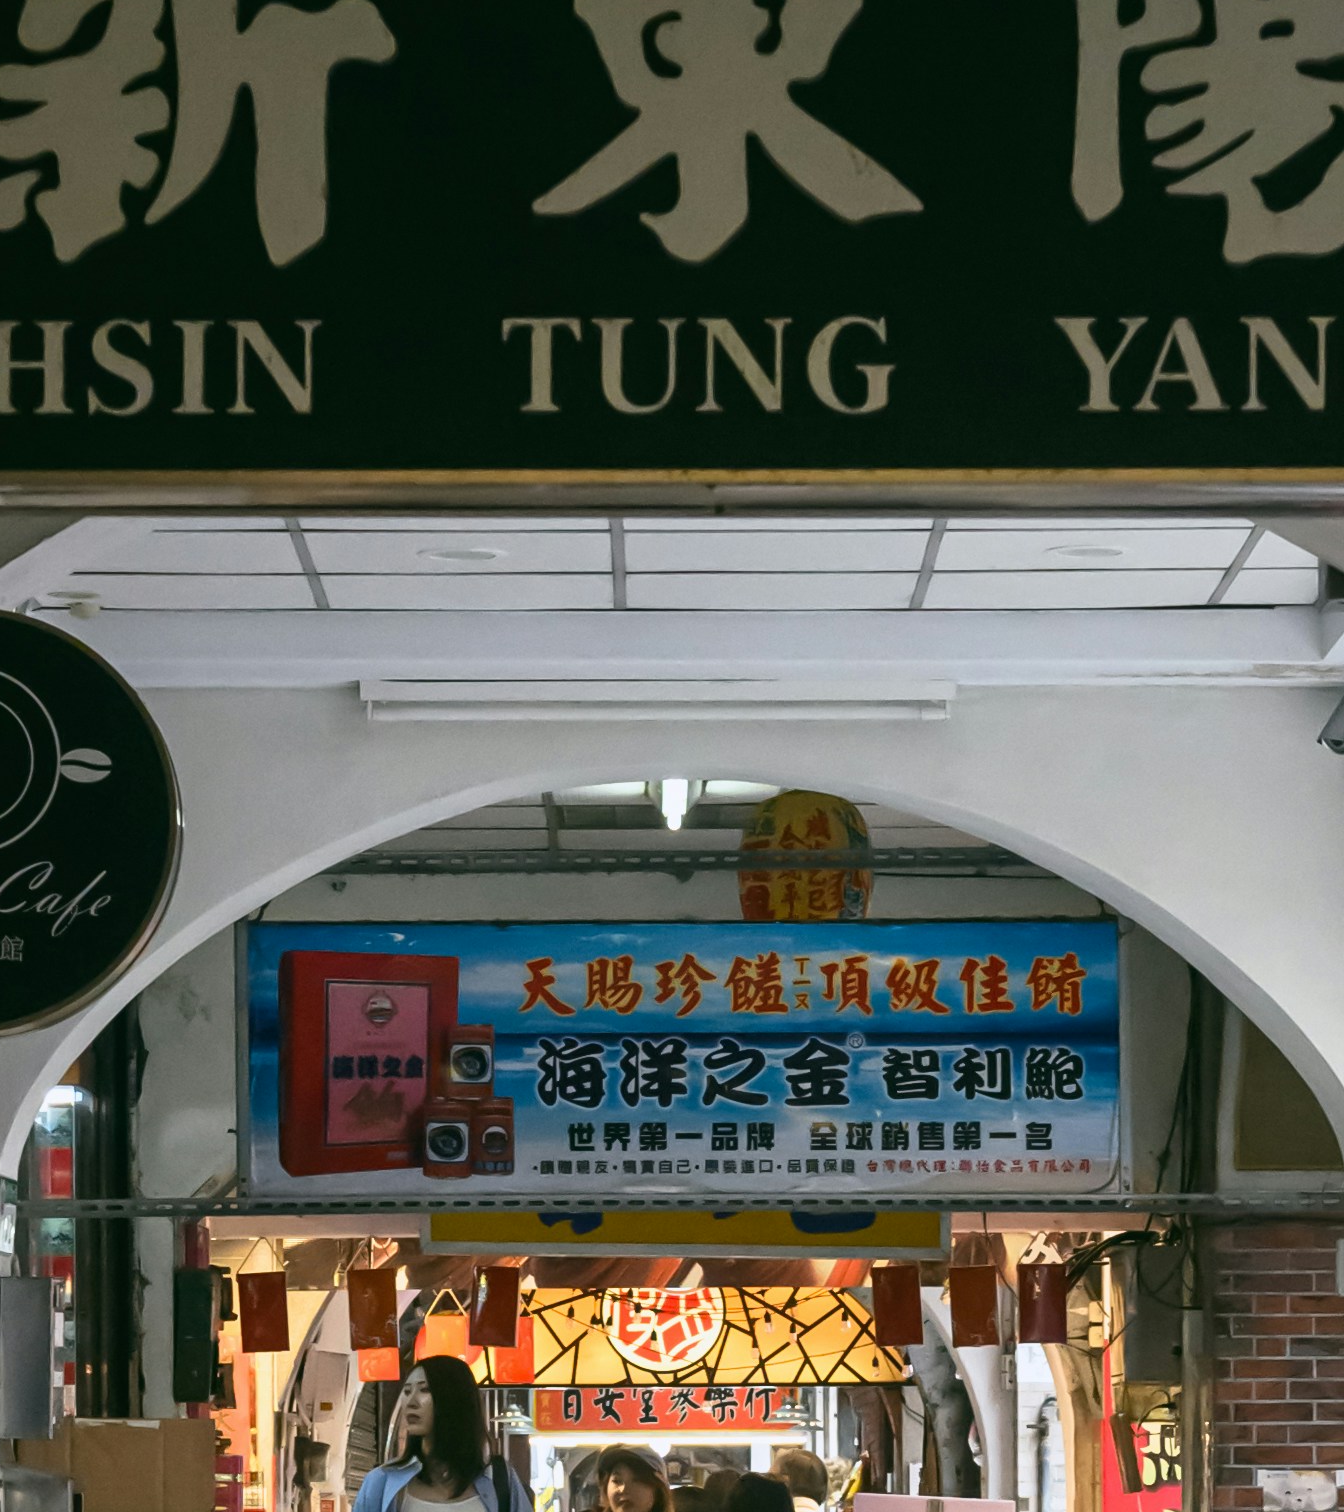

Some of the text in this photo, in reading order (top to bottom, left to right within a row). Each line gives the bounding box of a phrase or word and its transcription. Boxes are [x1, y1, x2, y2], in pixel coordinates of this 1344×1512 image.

[501, 316, 896, 417] TUNG
[536, 1035, 1086, 1109] 海洋之金 智利鮑
[567, 1121, 1053, 1152] 世界第一品牌 全球銷售第一名
